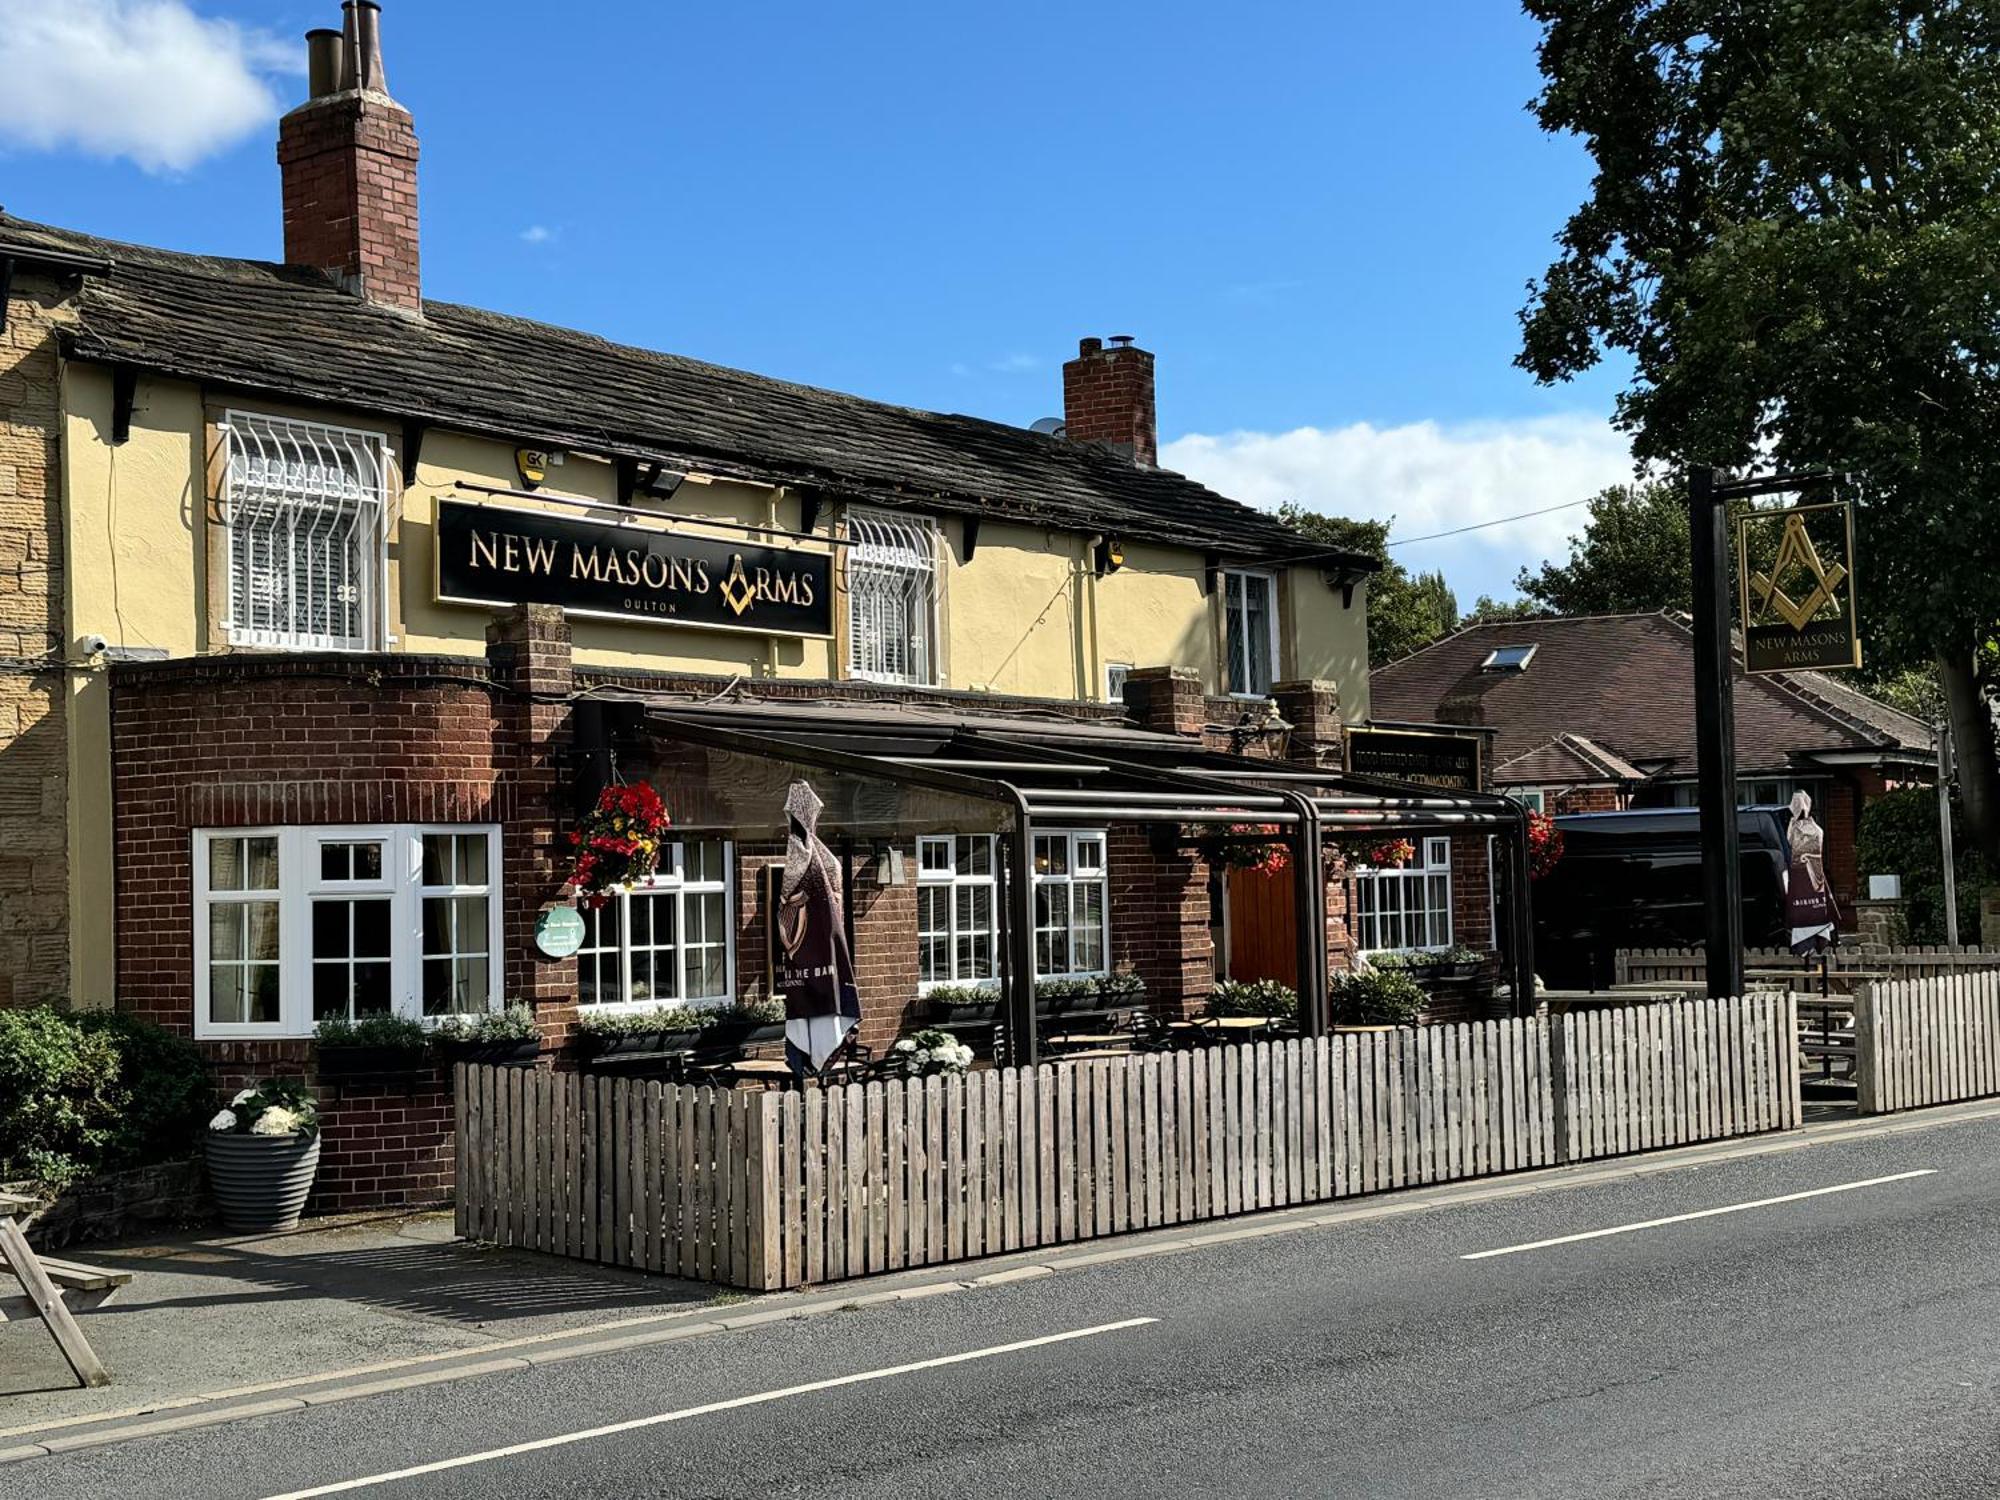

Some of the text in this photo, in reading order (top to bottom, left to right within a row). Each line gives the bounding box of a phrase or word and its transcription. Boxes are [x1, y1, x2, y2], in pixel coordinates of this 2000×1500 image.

[527, 452, 543, 467] GK
[469, 529, 559, 576] NEW
[570, 543, 711, 594] MASONS
[624, 598, 677, 613] OULTON
[1755, 631, 1846, 651] NEW MASONS
[1783, 650, 1820, 664] ARMS
